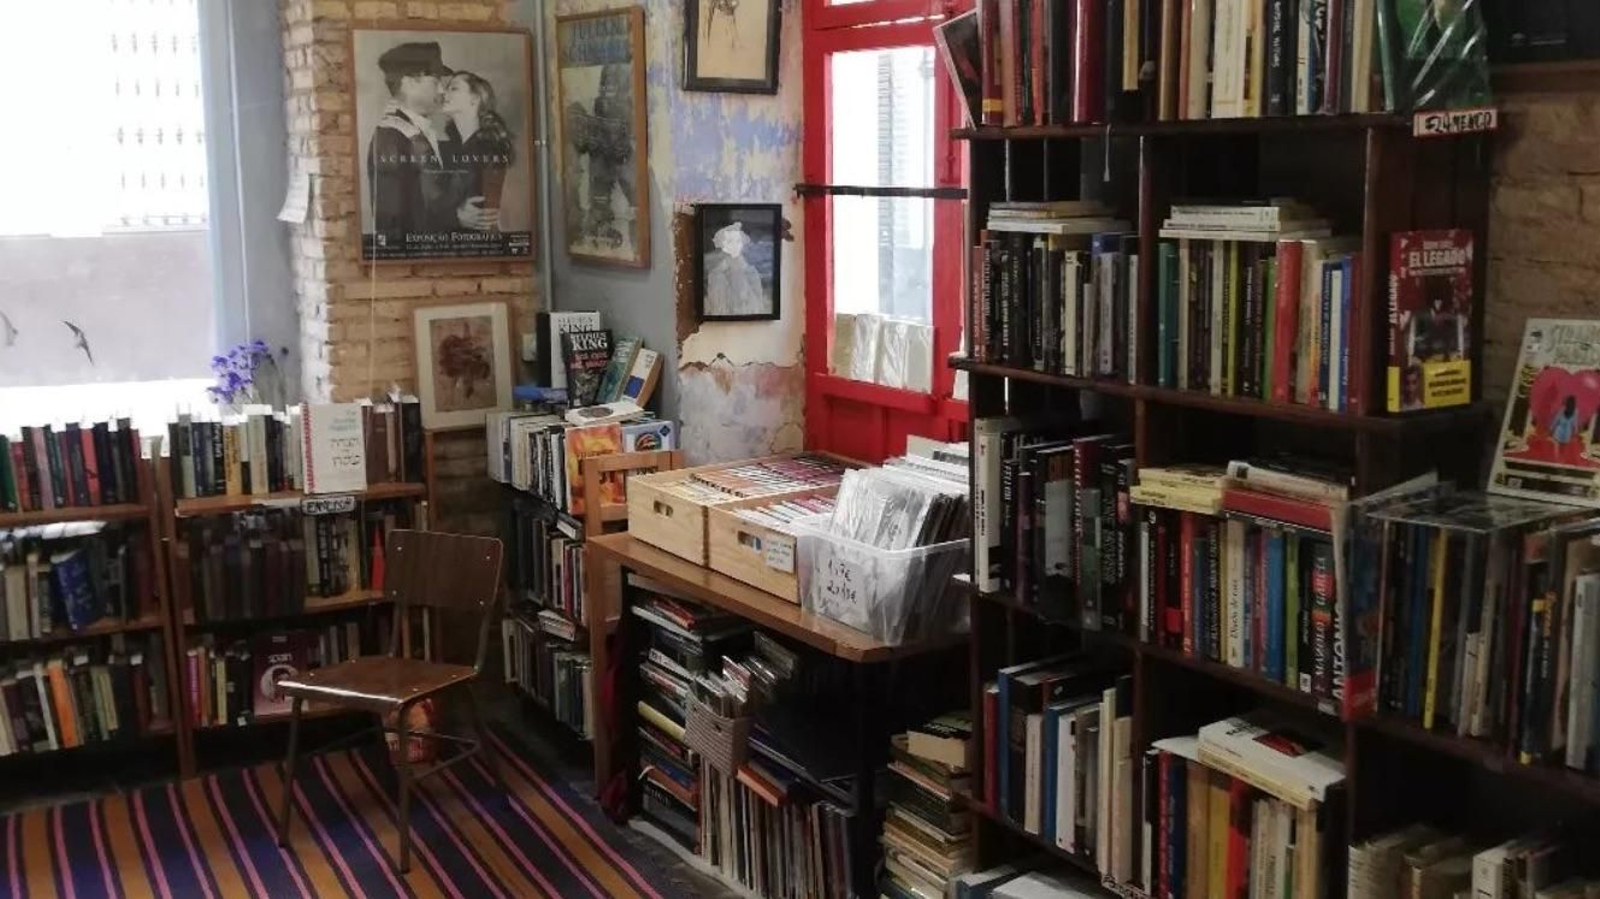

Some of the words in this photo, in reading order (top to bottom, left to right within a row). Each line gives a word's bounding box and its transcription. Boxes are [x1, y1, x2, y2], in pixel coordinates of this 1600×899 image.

[379, 153, 438, 164] SCREEN
[452, 153, 510, 164] LOVERS
[1408, 252, 1421, 268] EL
[1423, 248, 1466, 267] LEGADO
[572, 338, 608, 351] KING
